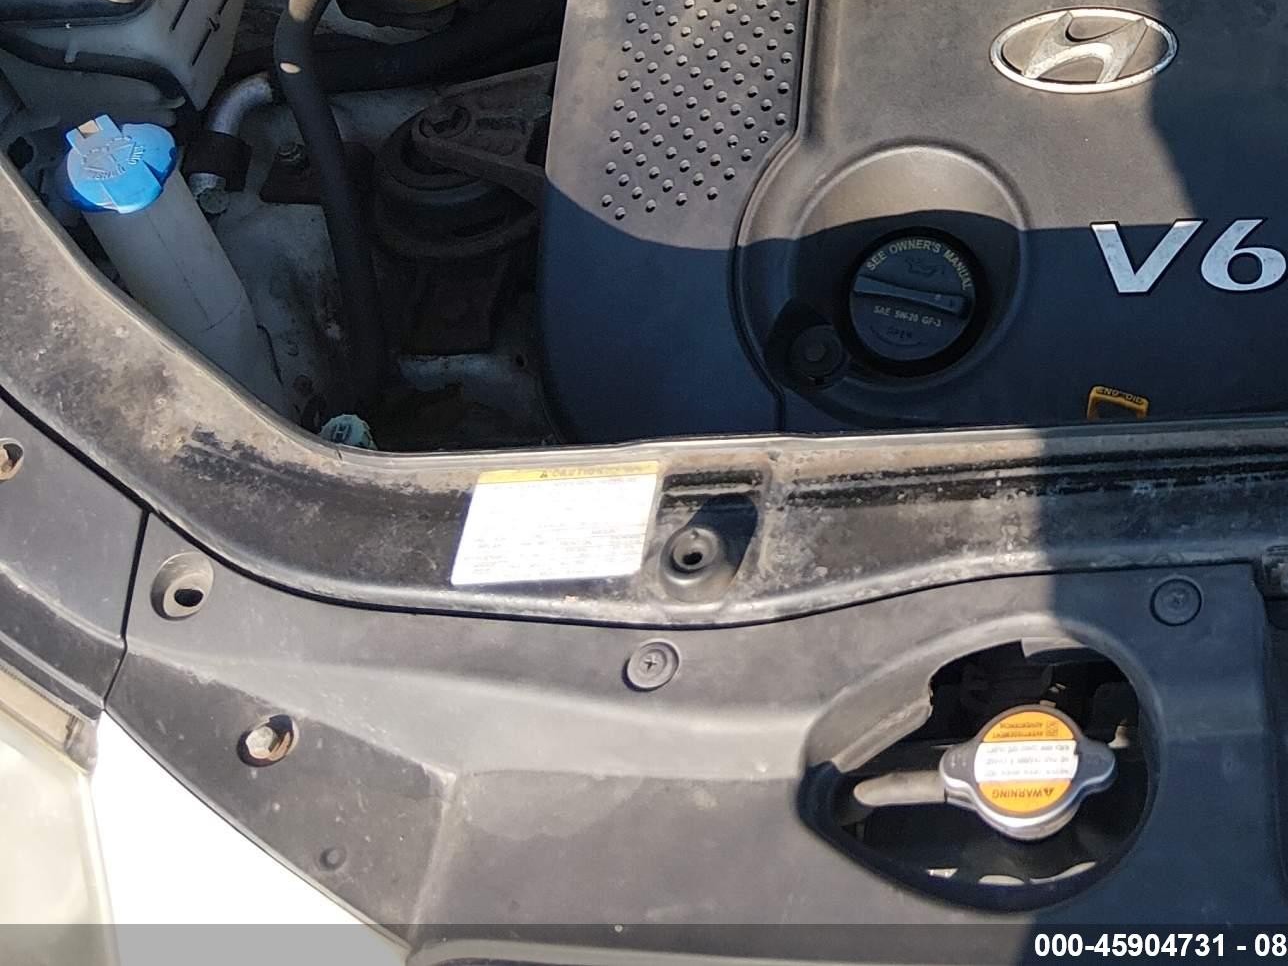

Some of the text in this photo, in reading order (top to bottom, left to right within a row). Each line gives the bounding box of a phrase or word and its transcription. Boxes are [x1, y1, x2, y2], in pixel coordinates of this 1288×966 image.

[866, 239, 973, 291] SEE OWNER'S MANUAL
[1090, 218, 1288, 293] V6
[873, 305, 891, 316] SAE
[991, 787, 1045, 799] WARNING
